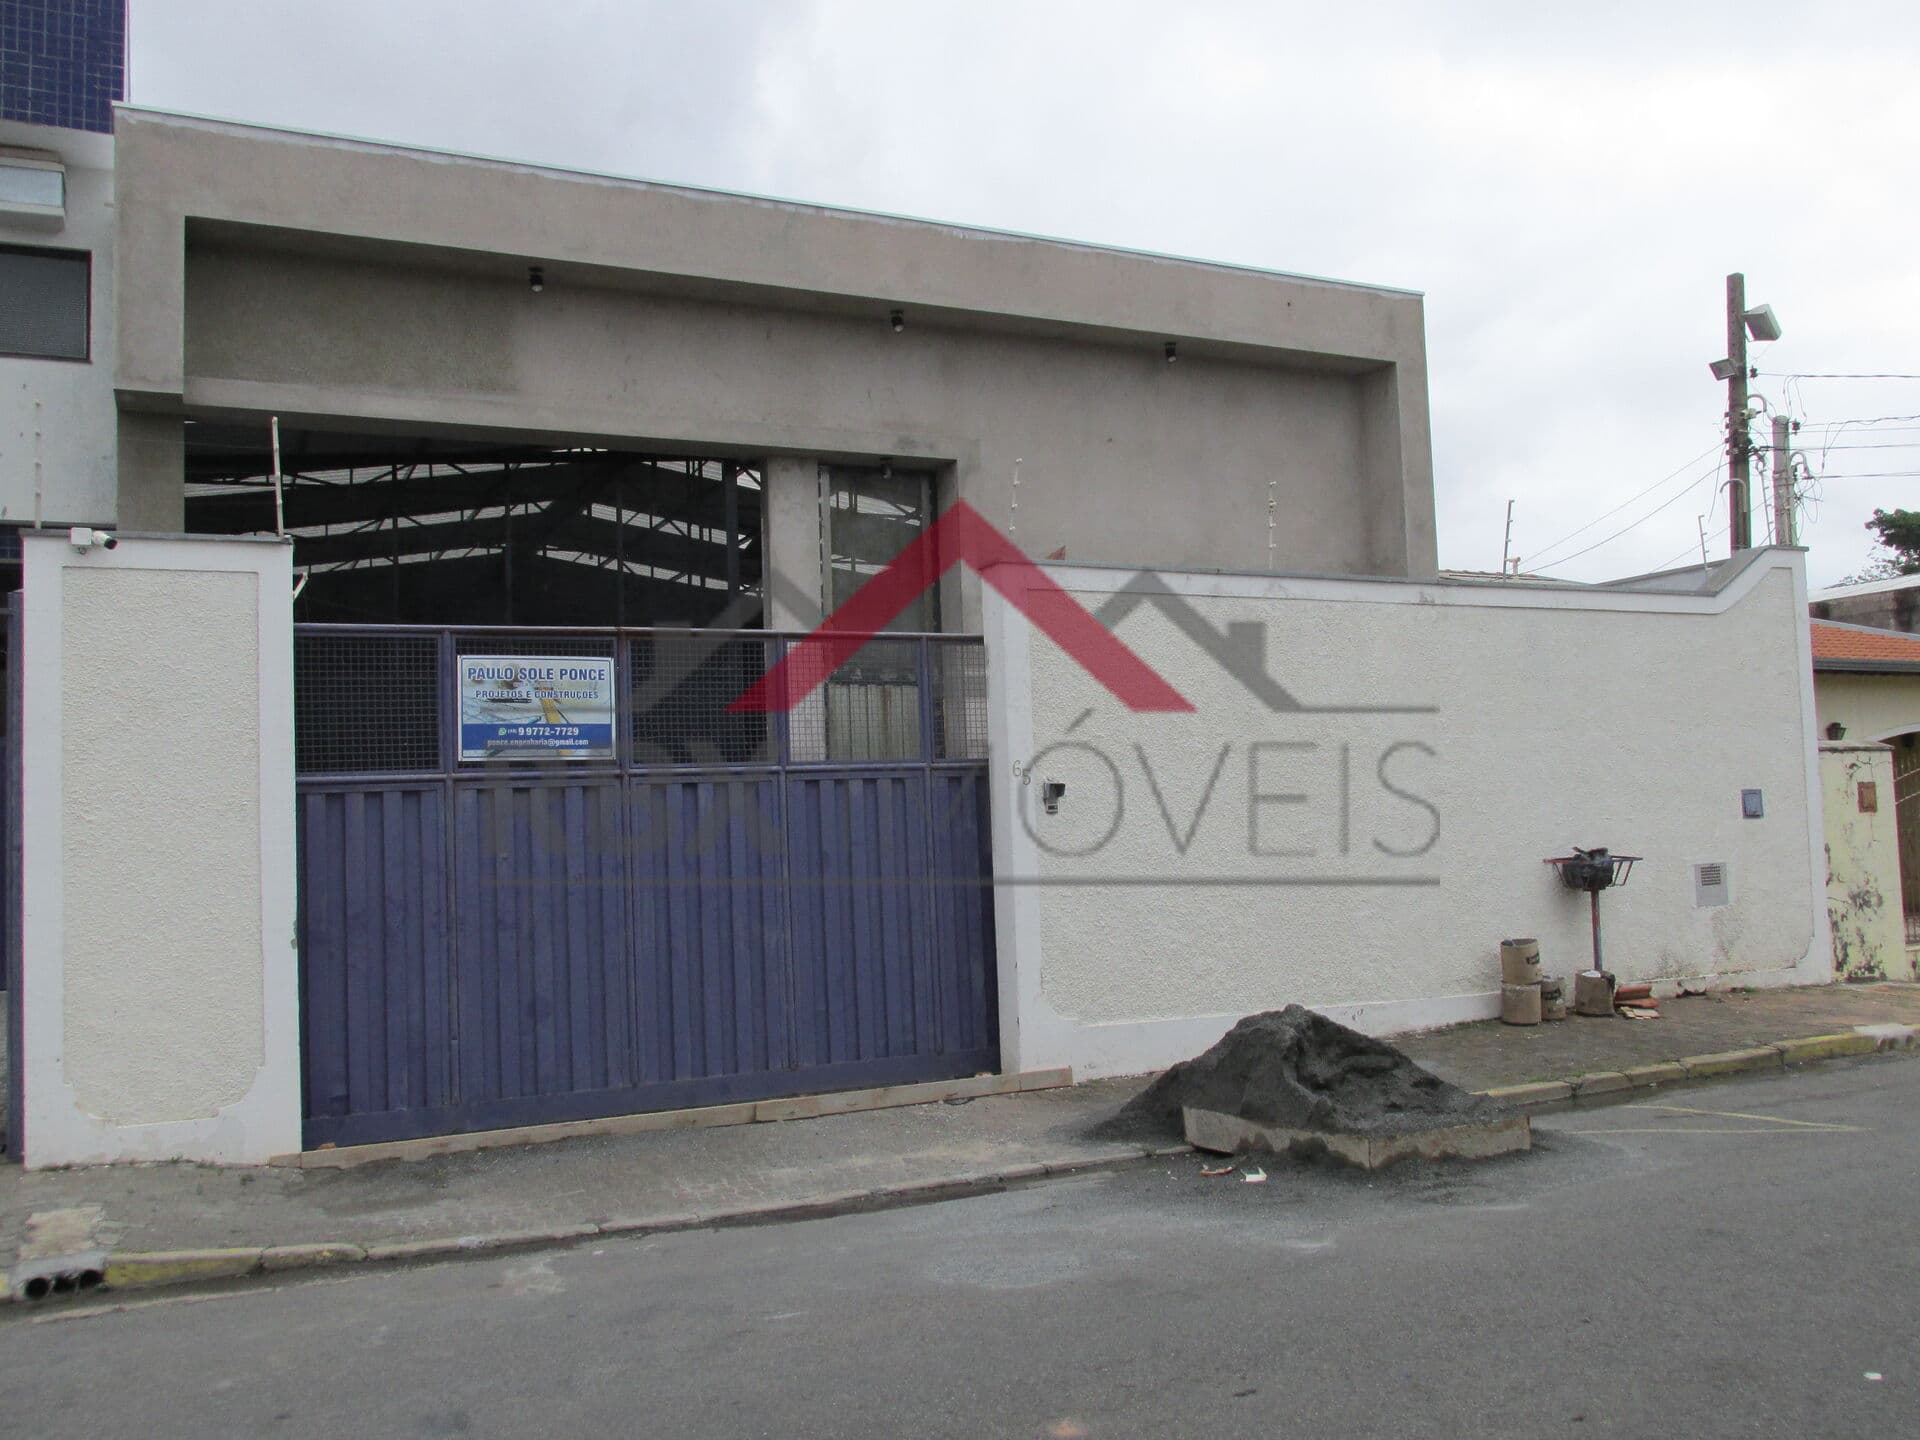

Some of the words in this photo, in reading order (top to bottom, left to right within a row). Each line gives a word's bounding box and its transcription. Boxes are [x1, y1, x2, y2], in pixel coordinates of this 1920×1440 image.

[467, 667, 514, 680] PAULO
[519, 668, 554, 680] SOLE
[559, 669, 605, 681] PONCE
[475, 690, 523, 699] PROJETOS
